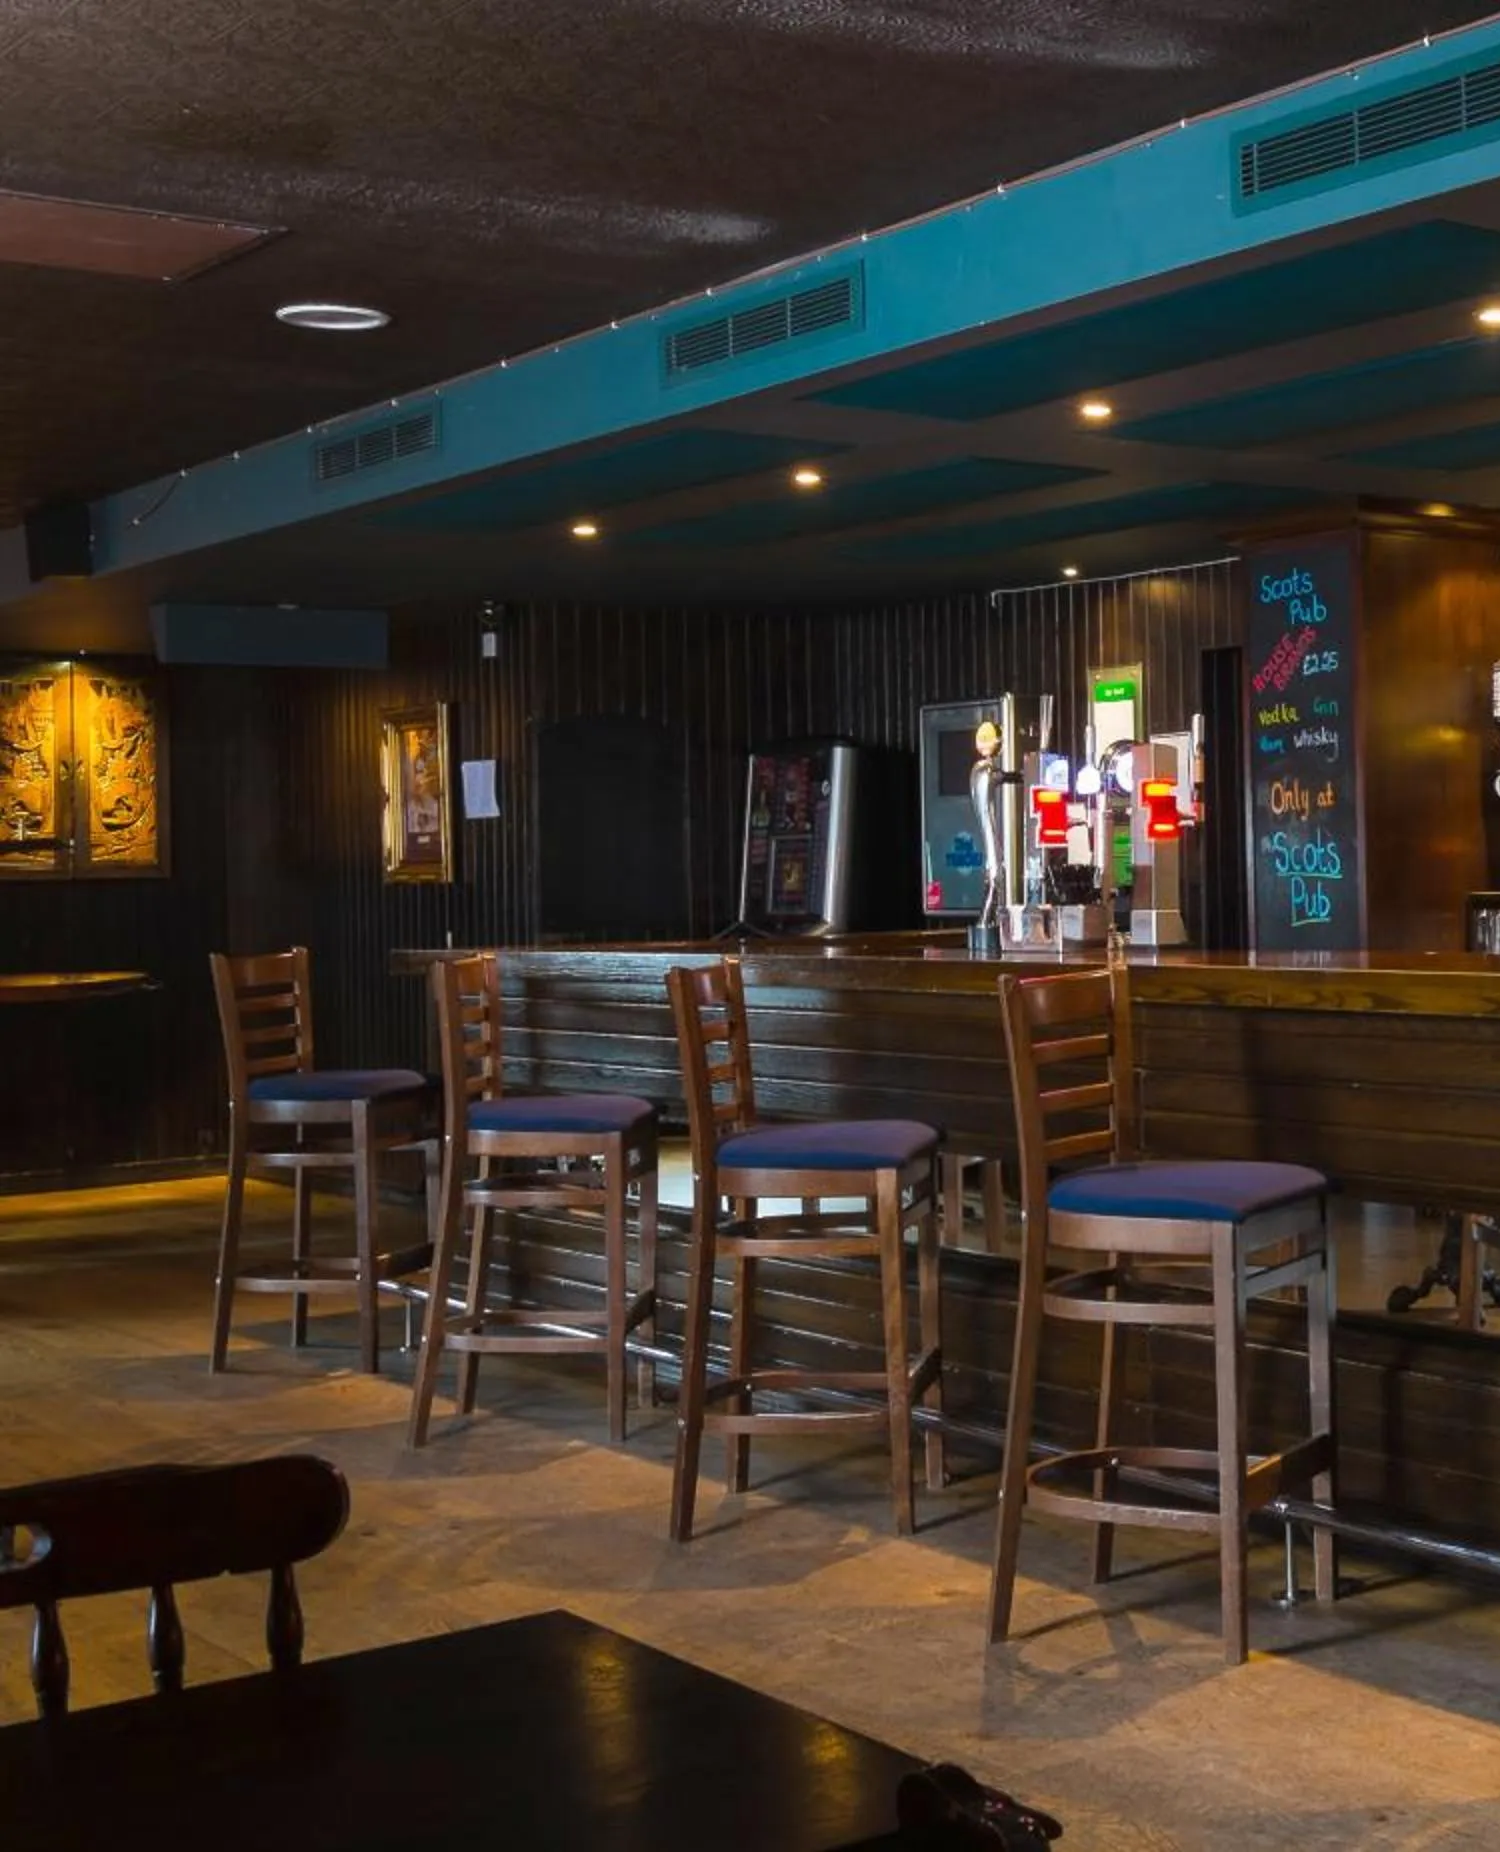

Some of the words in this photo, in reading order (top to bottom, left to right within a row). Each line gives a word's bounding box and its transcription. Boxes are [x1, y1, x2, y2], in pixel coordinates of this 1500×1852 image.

[1260, 568, 1313, 603] Scots
[1290, 594, 1327, 625] Pub
[1270, 781, 1309, 821] Only
[1316, 781, 1335, 807] at
[1272, 826, 1342, 876] Scots
[1290, 876, 1331, 923] Pub
